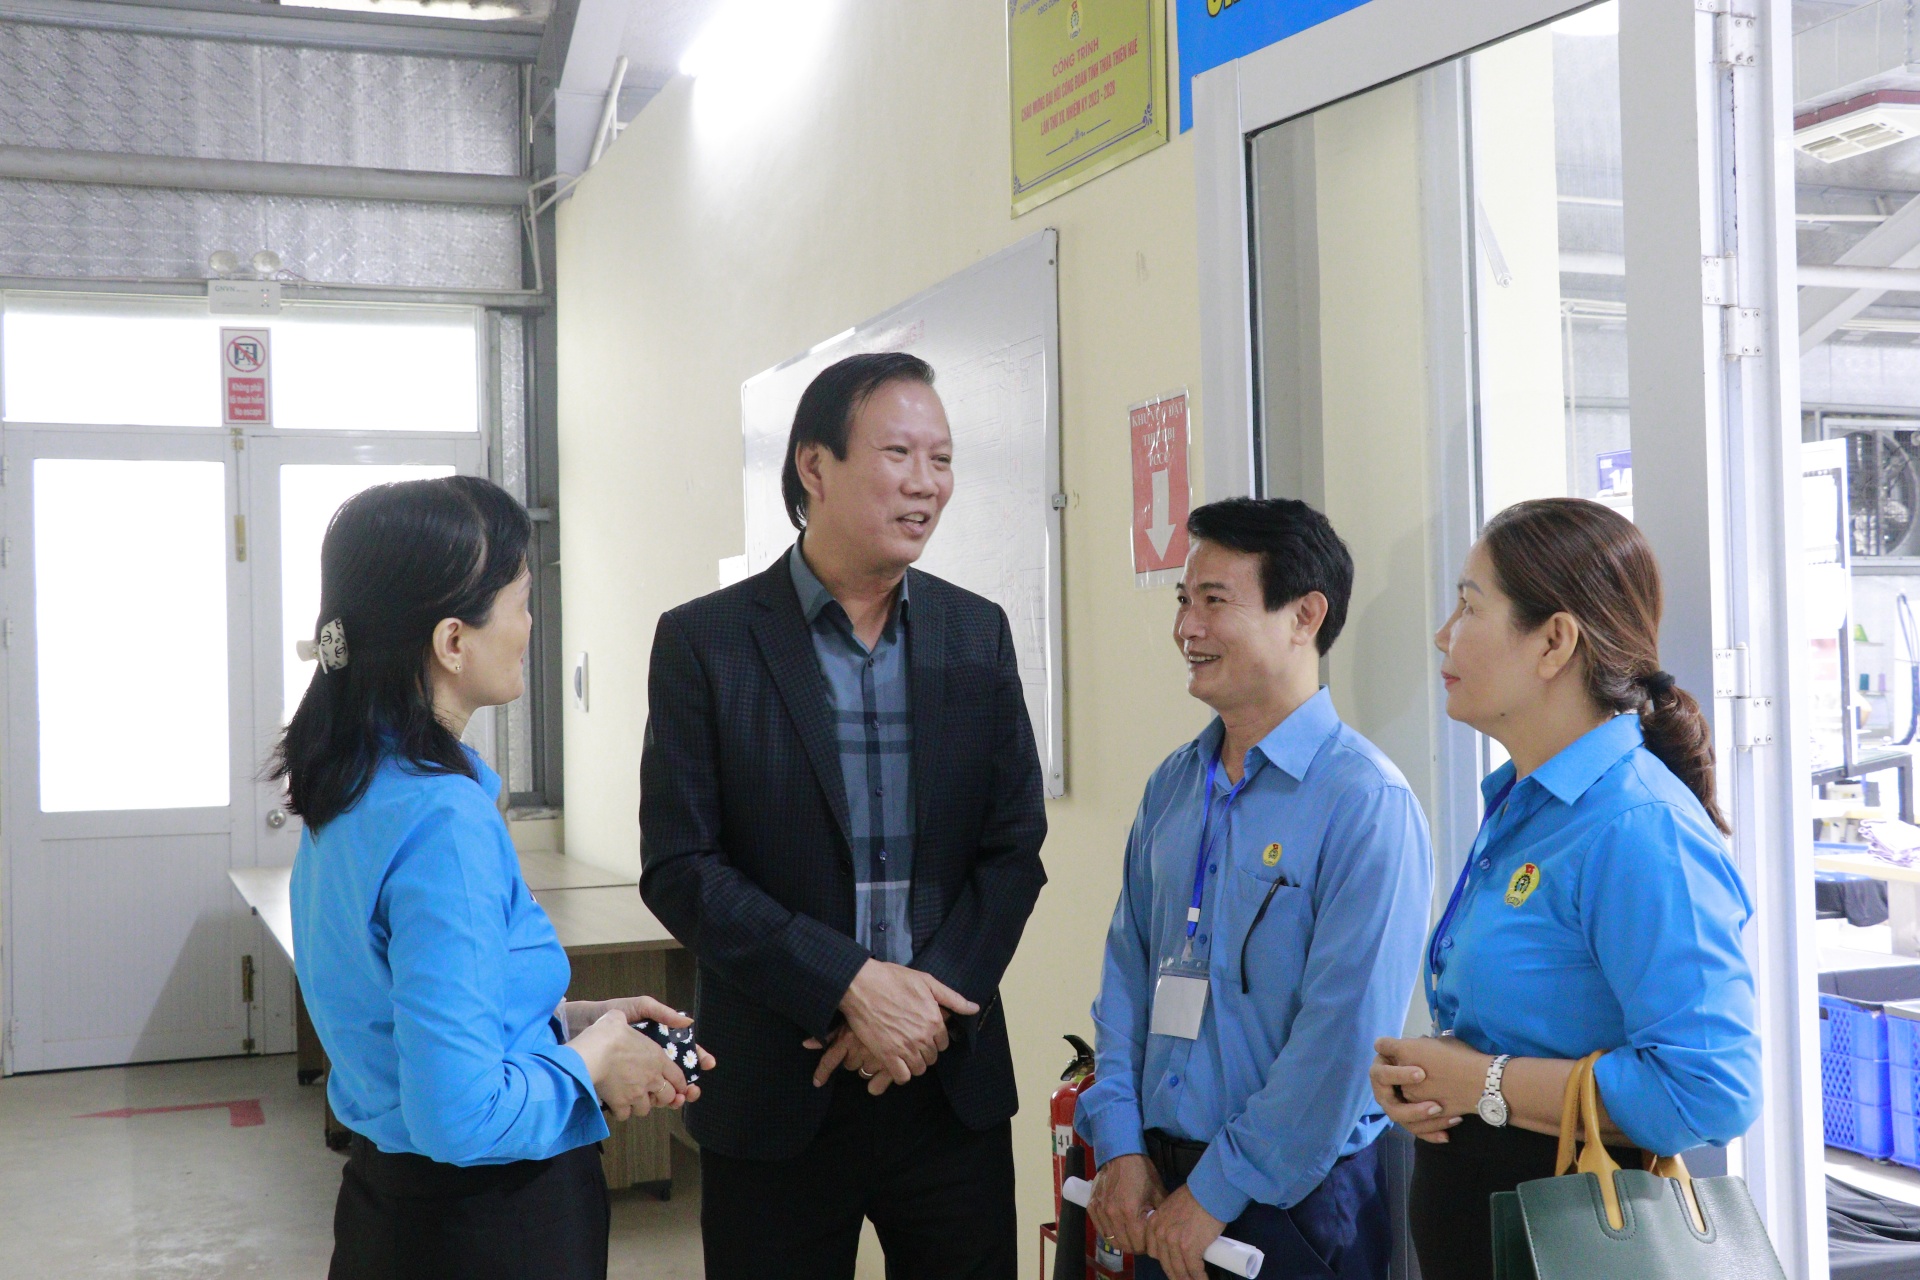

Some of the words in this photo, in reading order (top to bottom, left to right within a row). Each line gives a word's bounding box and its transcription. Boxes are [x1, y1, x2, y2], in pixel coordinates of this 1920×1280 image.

[1052, 53, 1075, 77] CÔNG
[1077, 37, 1099, 62] TRÌNH
[1131, 412, 1149, 428] KHU
[1057, 1134, 1070, 1148] 41
